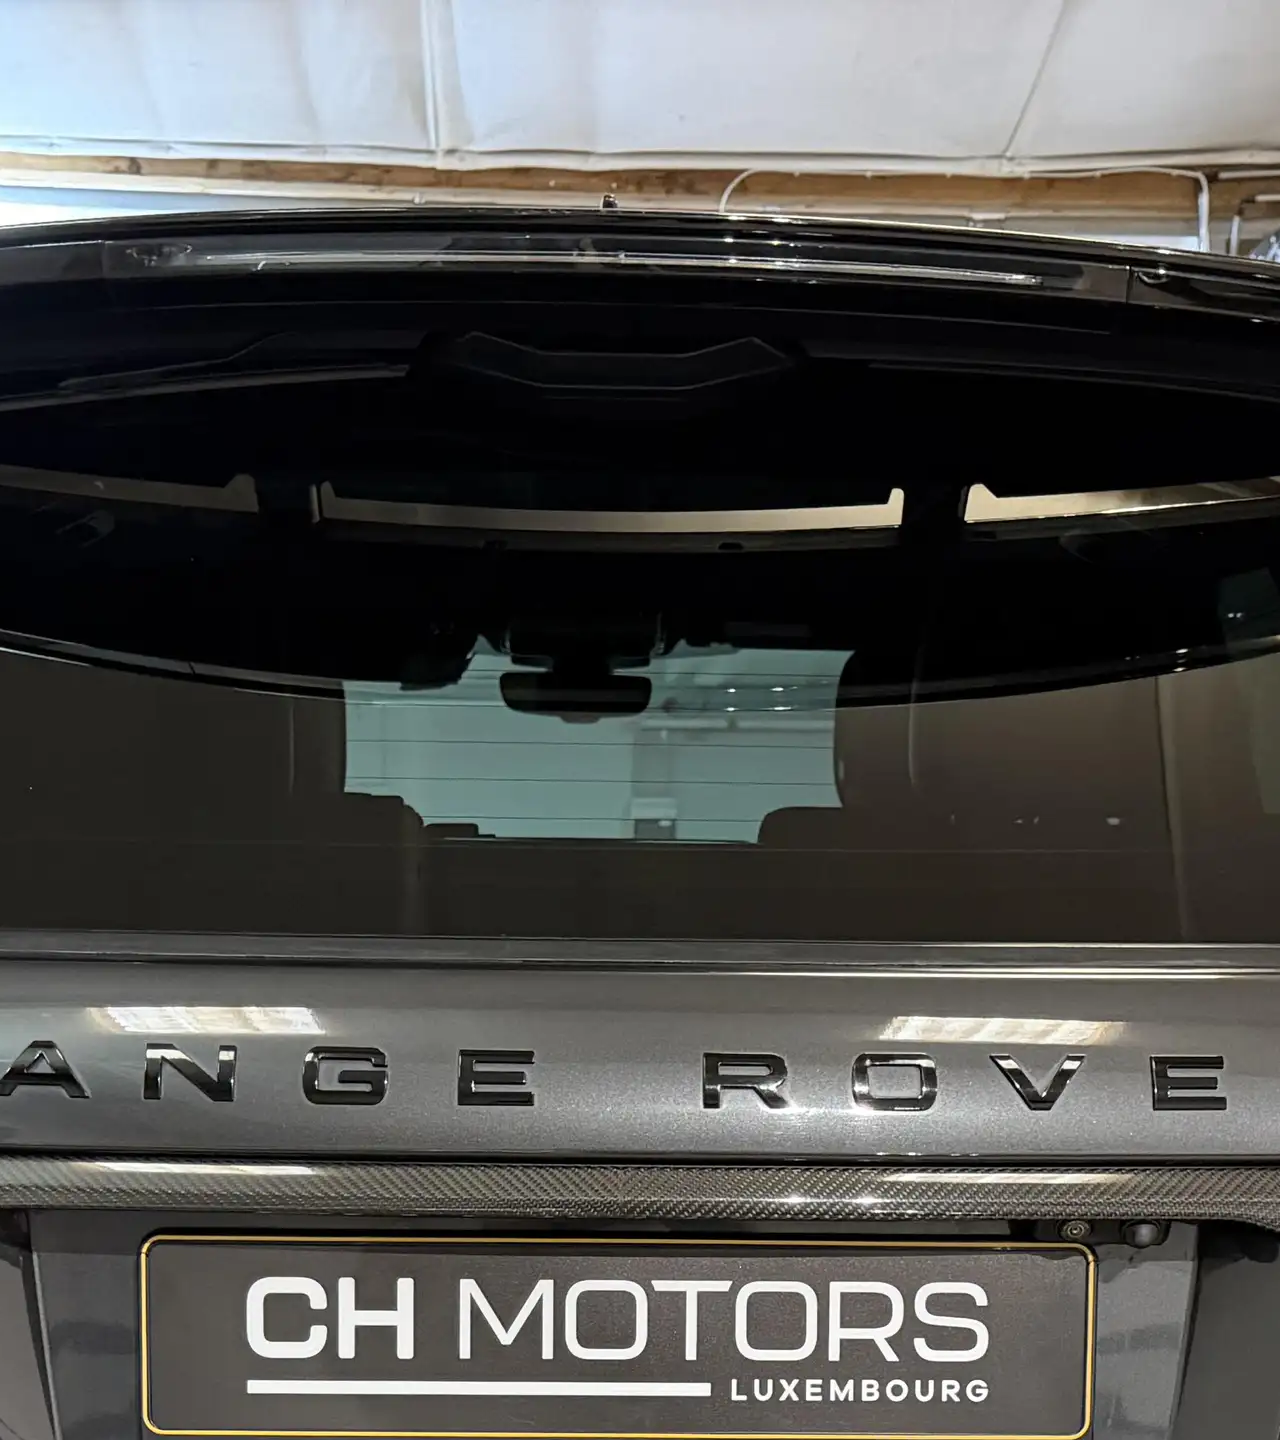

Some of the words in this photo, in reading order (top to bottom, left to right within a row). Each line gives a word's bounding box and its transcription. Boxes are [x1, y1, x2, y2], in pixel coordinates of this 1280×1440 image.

[246, 1276, 414, 1360] CH
[459, 1278, 990, 1362] MOTORS
[731, 1378, 990, 1402] LUXEMBOURG
